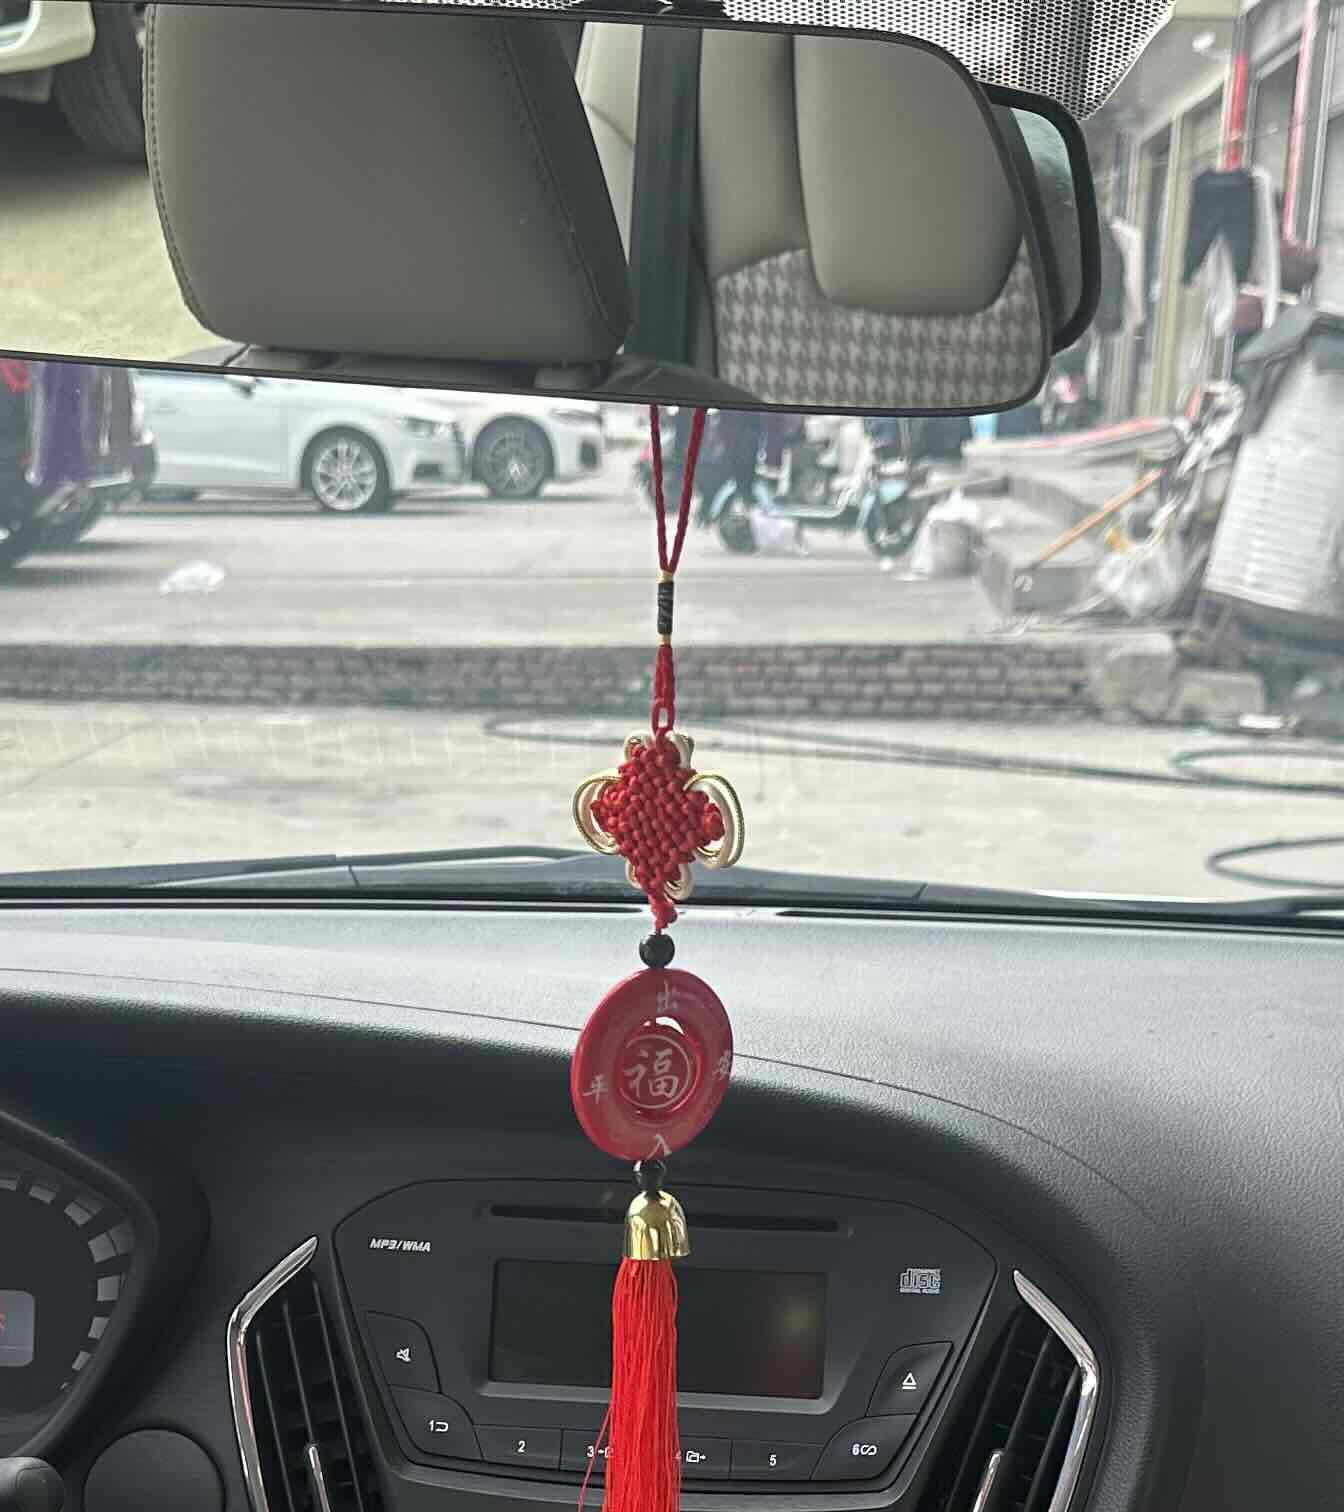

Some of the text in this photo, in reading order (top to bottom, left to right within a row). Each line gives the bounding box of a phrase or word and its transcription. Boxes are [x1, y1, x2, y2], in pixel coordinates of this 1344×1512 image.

[623, 1048, 679, 1098] 福
[582, 1074, 609, 1104] 平
[369, 1238, 432, 1252] MP3/WMA
[517, 1440, 526, 1454] 2
[586, 1445, 595, 1458] 3
[851, 1443, 860, 1456] 6
[768, 1454, 777, 1467] 5
